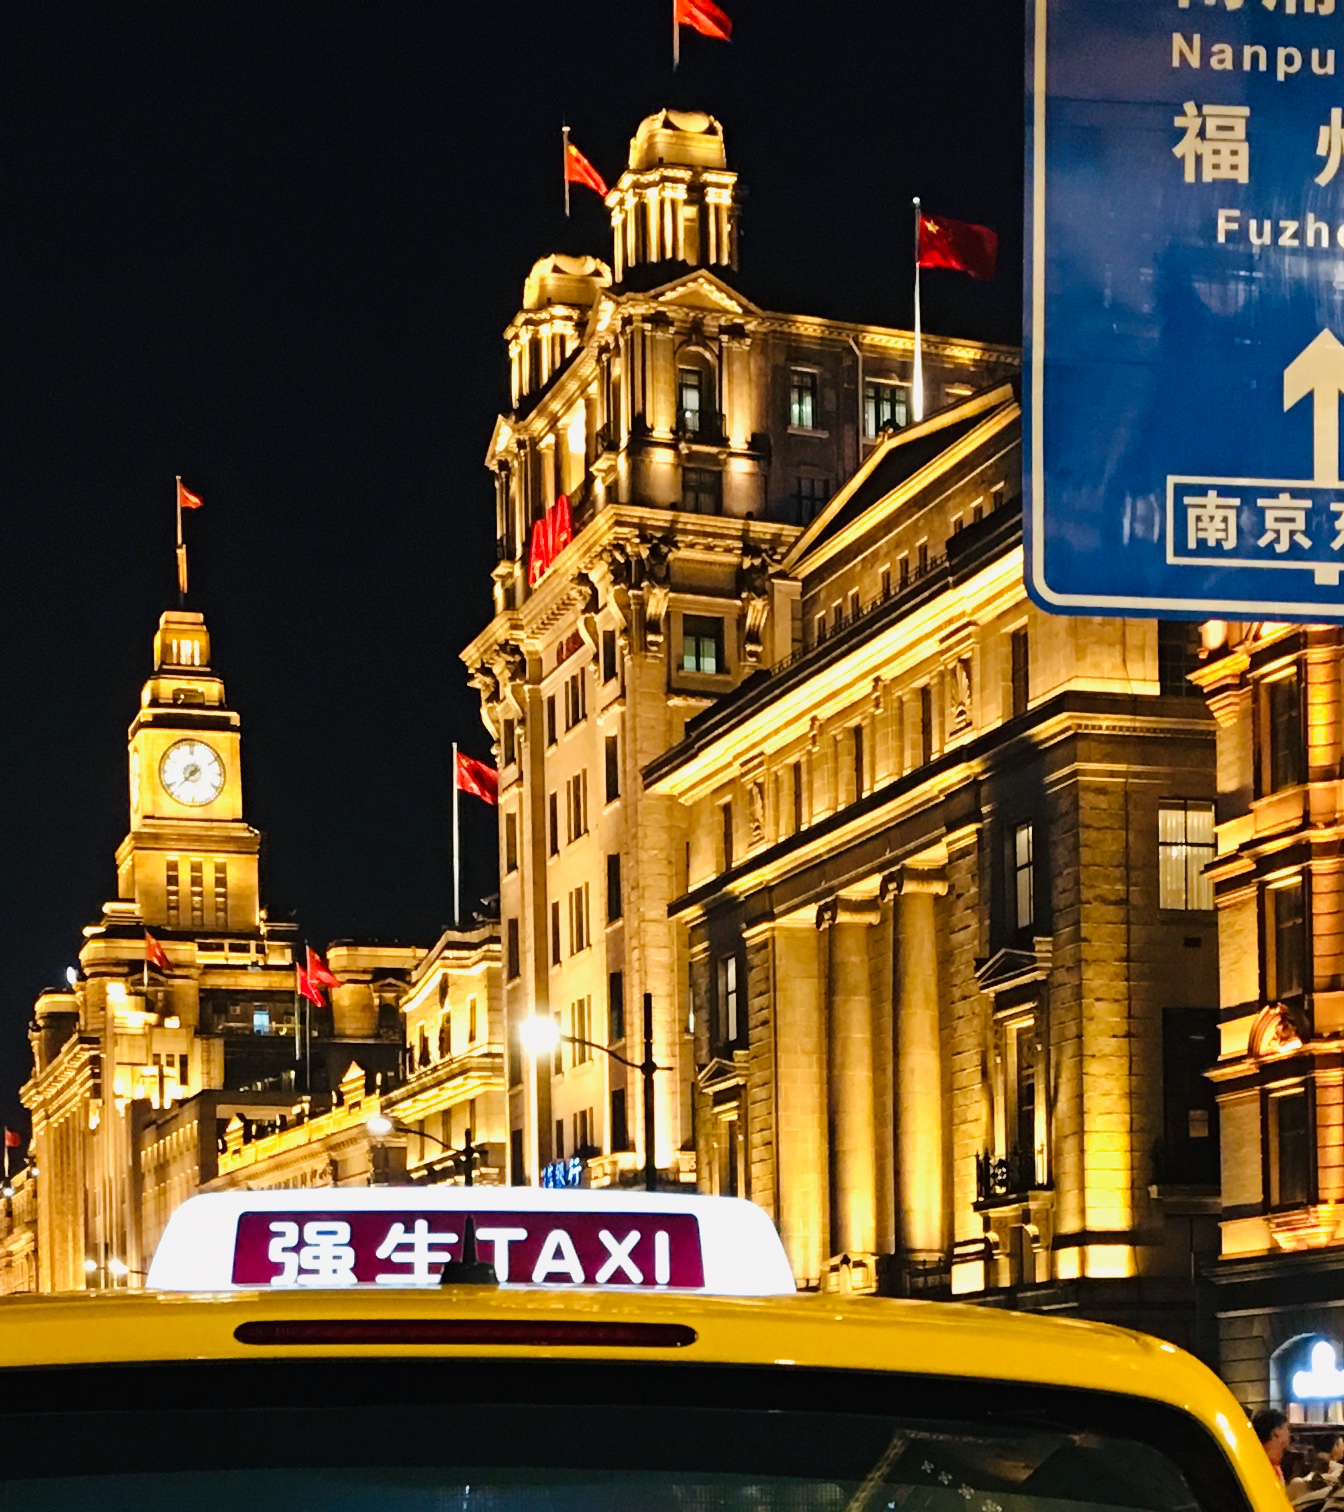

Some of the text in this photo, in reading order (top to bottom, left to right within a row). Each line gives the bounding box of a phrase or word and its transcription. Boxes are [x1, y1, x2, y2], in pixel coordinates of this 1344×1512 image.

[1171, 33, 1336, 82] Nanpu
[268, 1218, 670, 1286] 强生 TAXI
